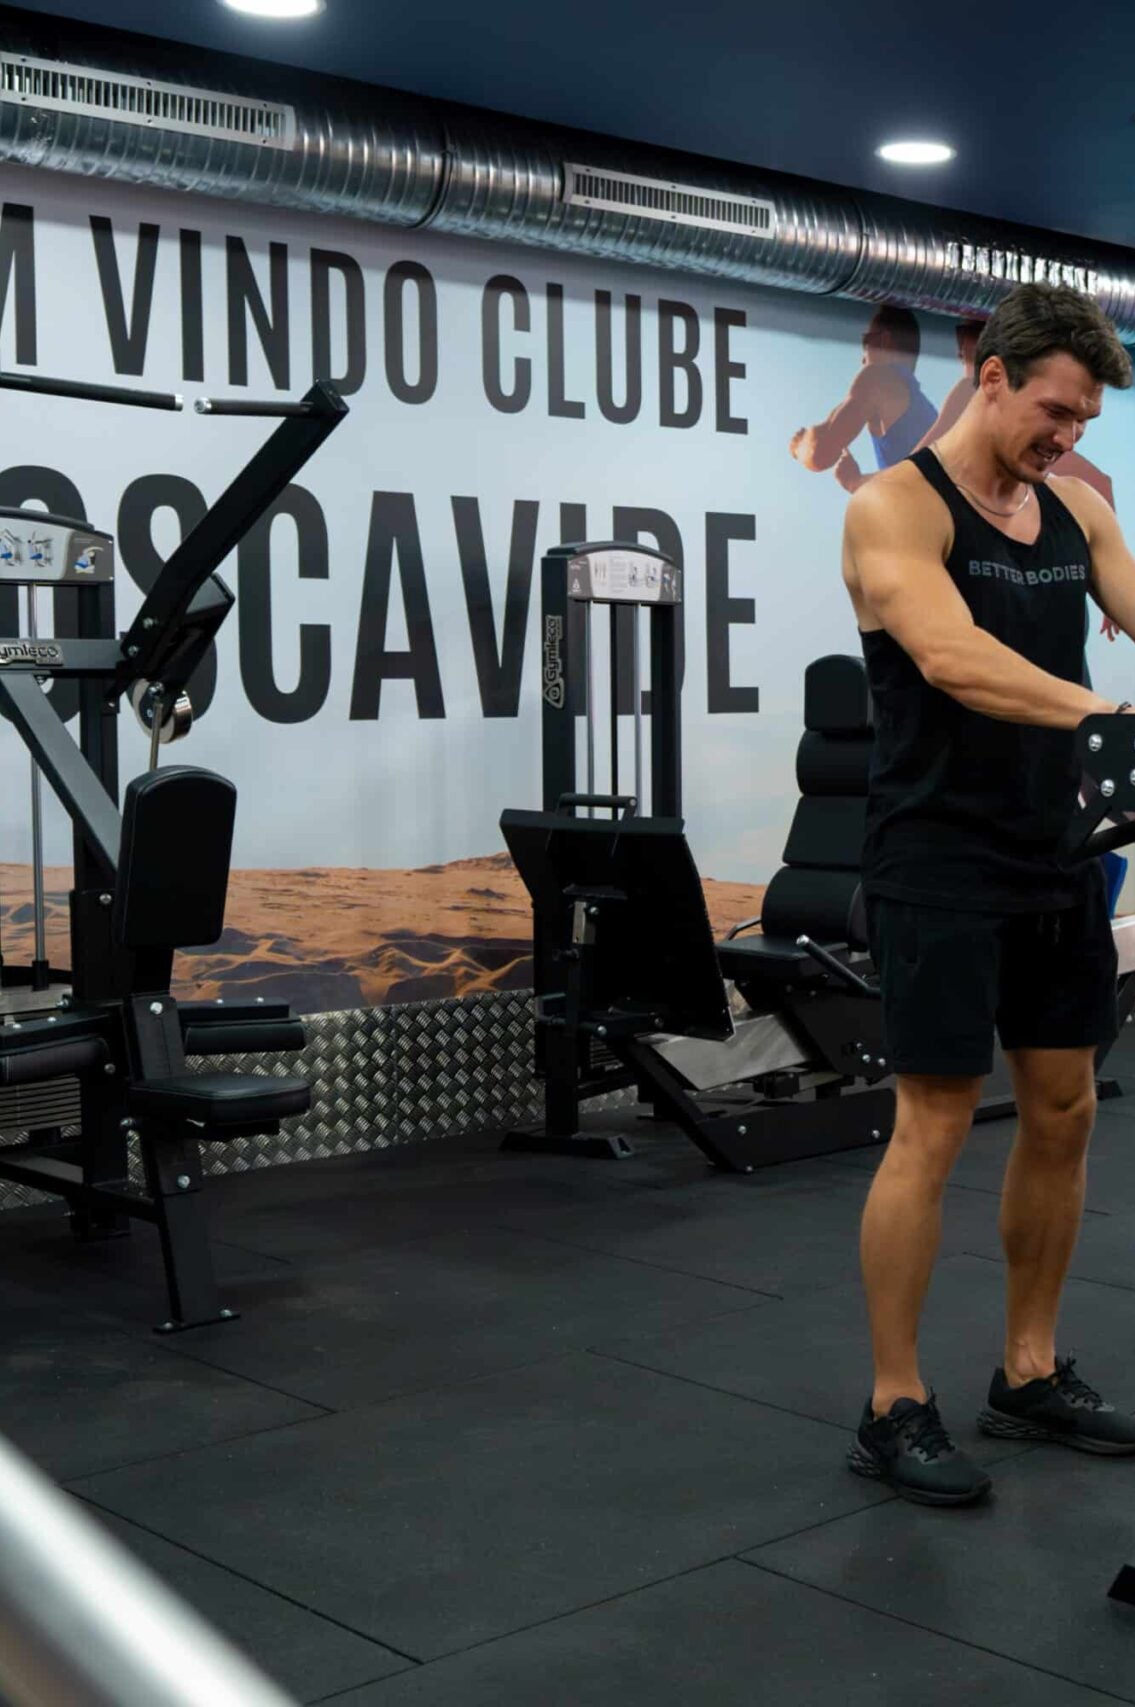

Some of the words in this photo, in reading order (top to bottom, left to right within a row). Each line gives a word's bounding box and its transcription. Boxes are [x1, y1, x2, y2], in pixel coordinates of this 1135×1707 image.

[89, 214, 439, 406] VINDO
[481, 273, 748, 435] CLUBE
[1025, 564, 1086, 585] BODIES
